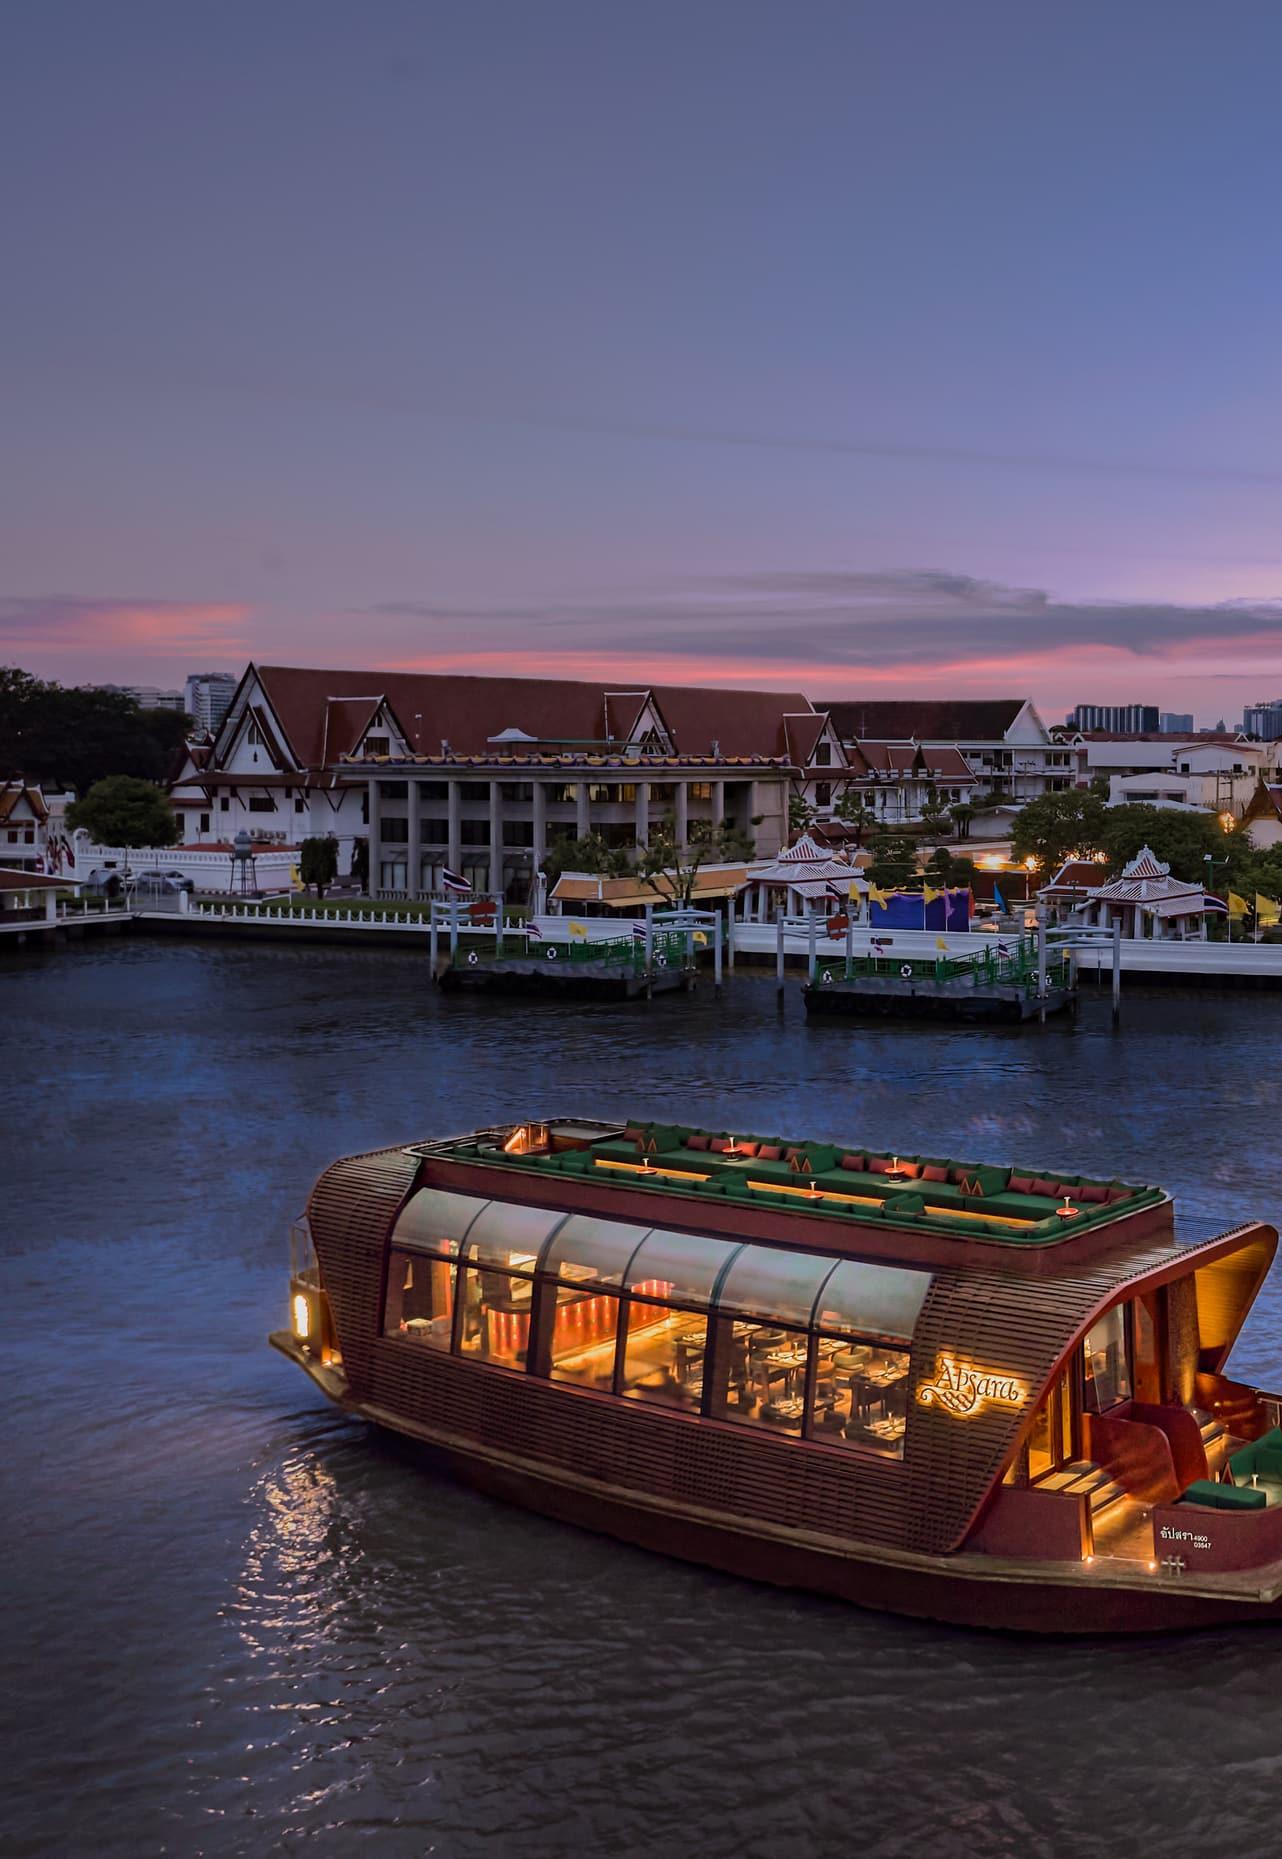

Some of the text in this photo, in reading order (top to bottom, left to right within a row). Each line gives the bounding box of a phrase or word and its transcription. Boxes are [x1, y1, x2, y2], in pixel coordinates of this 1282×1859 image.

[922, 1357, 1019, 1412] Apsara
[1160, 1526, 1193, 1541] อัปสรา
